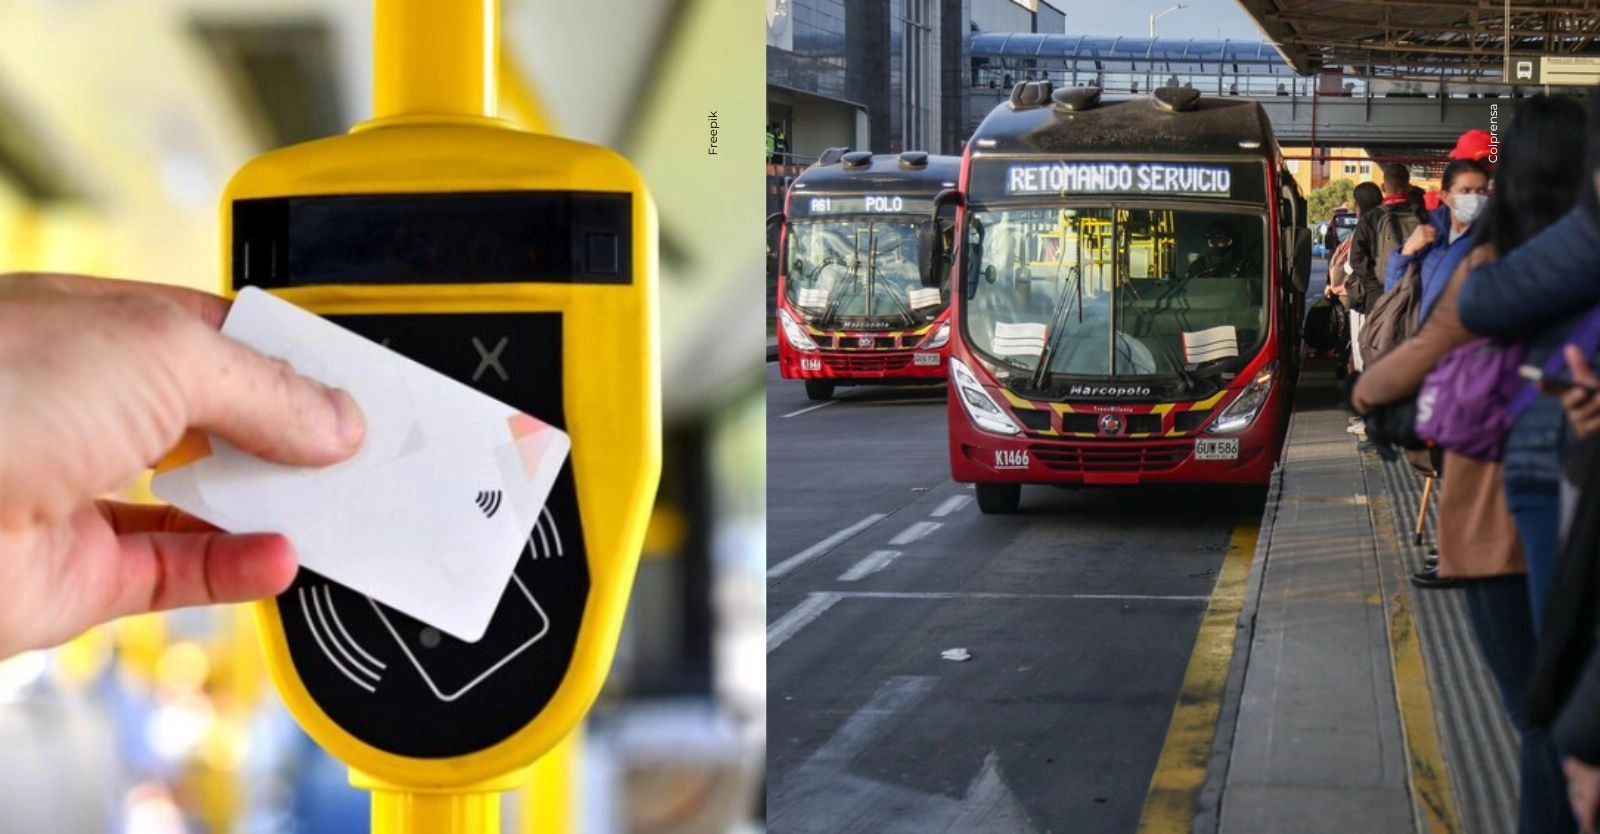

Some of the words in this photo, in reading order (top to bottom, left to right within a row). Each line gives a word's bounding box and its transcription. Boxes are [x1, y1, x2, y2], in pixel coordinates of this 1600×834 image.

[1010, 166, 1132, 191] RETOMANDO
[1137, 167, 1231, 191] SERVICIO
[865, 197, 902, 212] POLO
[1070, 385, 1150, 396] Marcopolo
[1218, 441, 1237, 454] 586
[995, 450, 1029, 465] K1466
